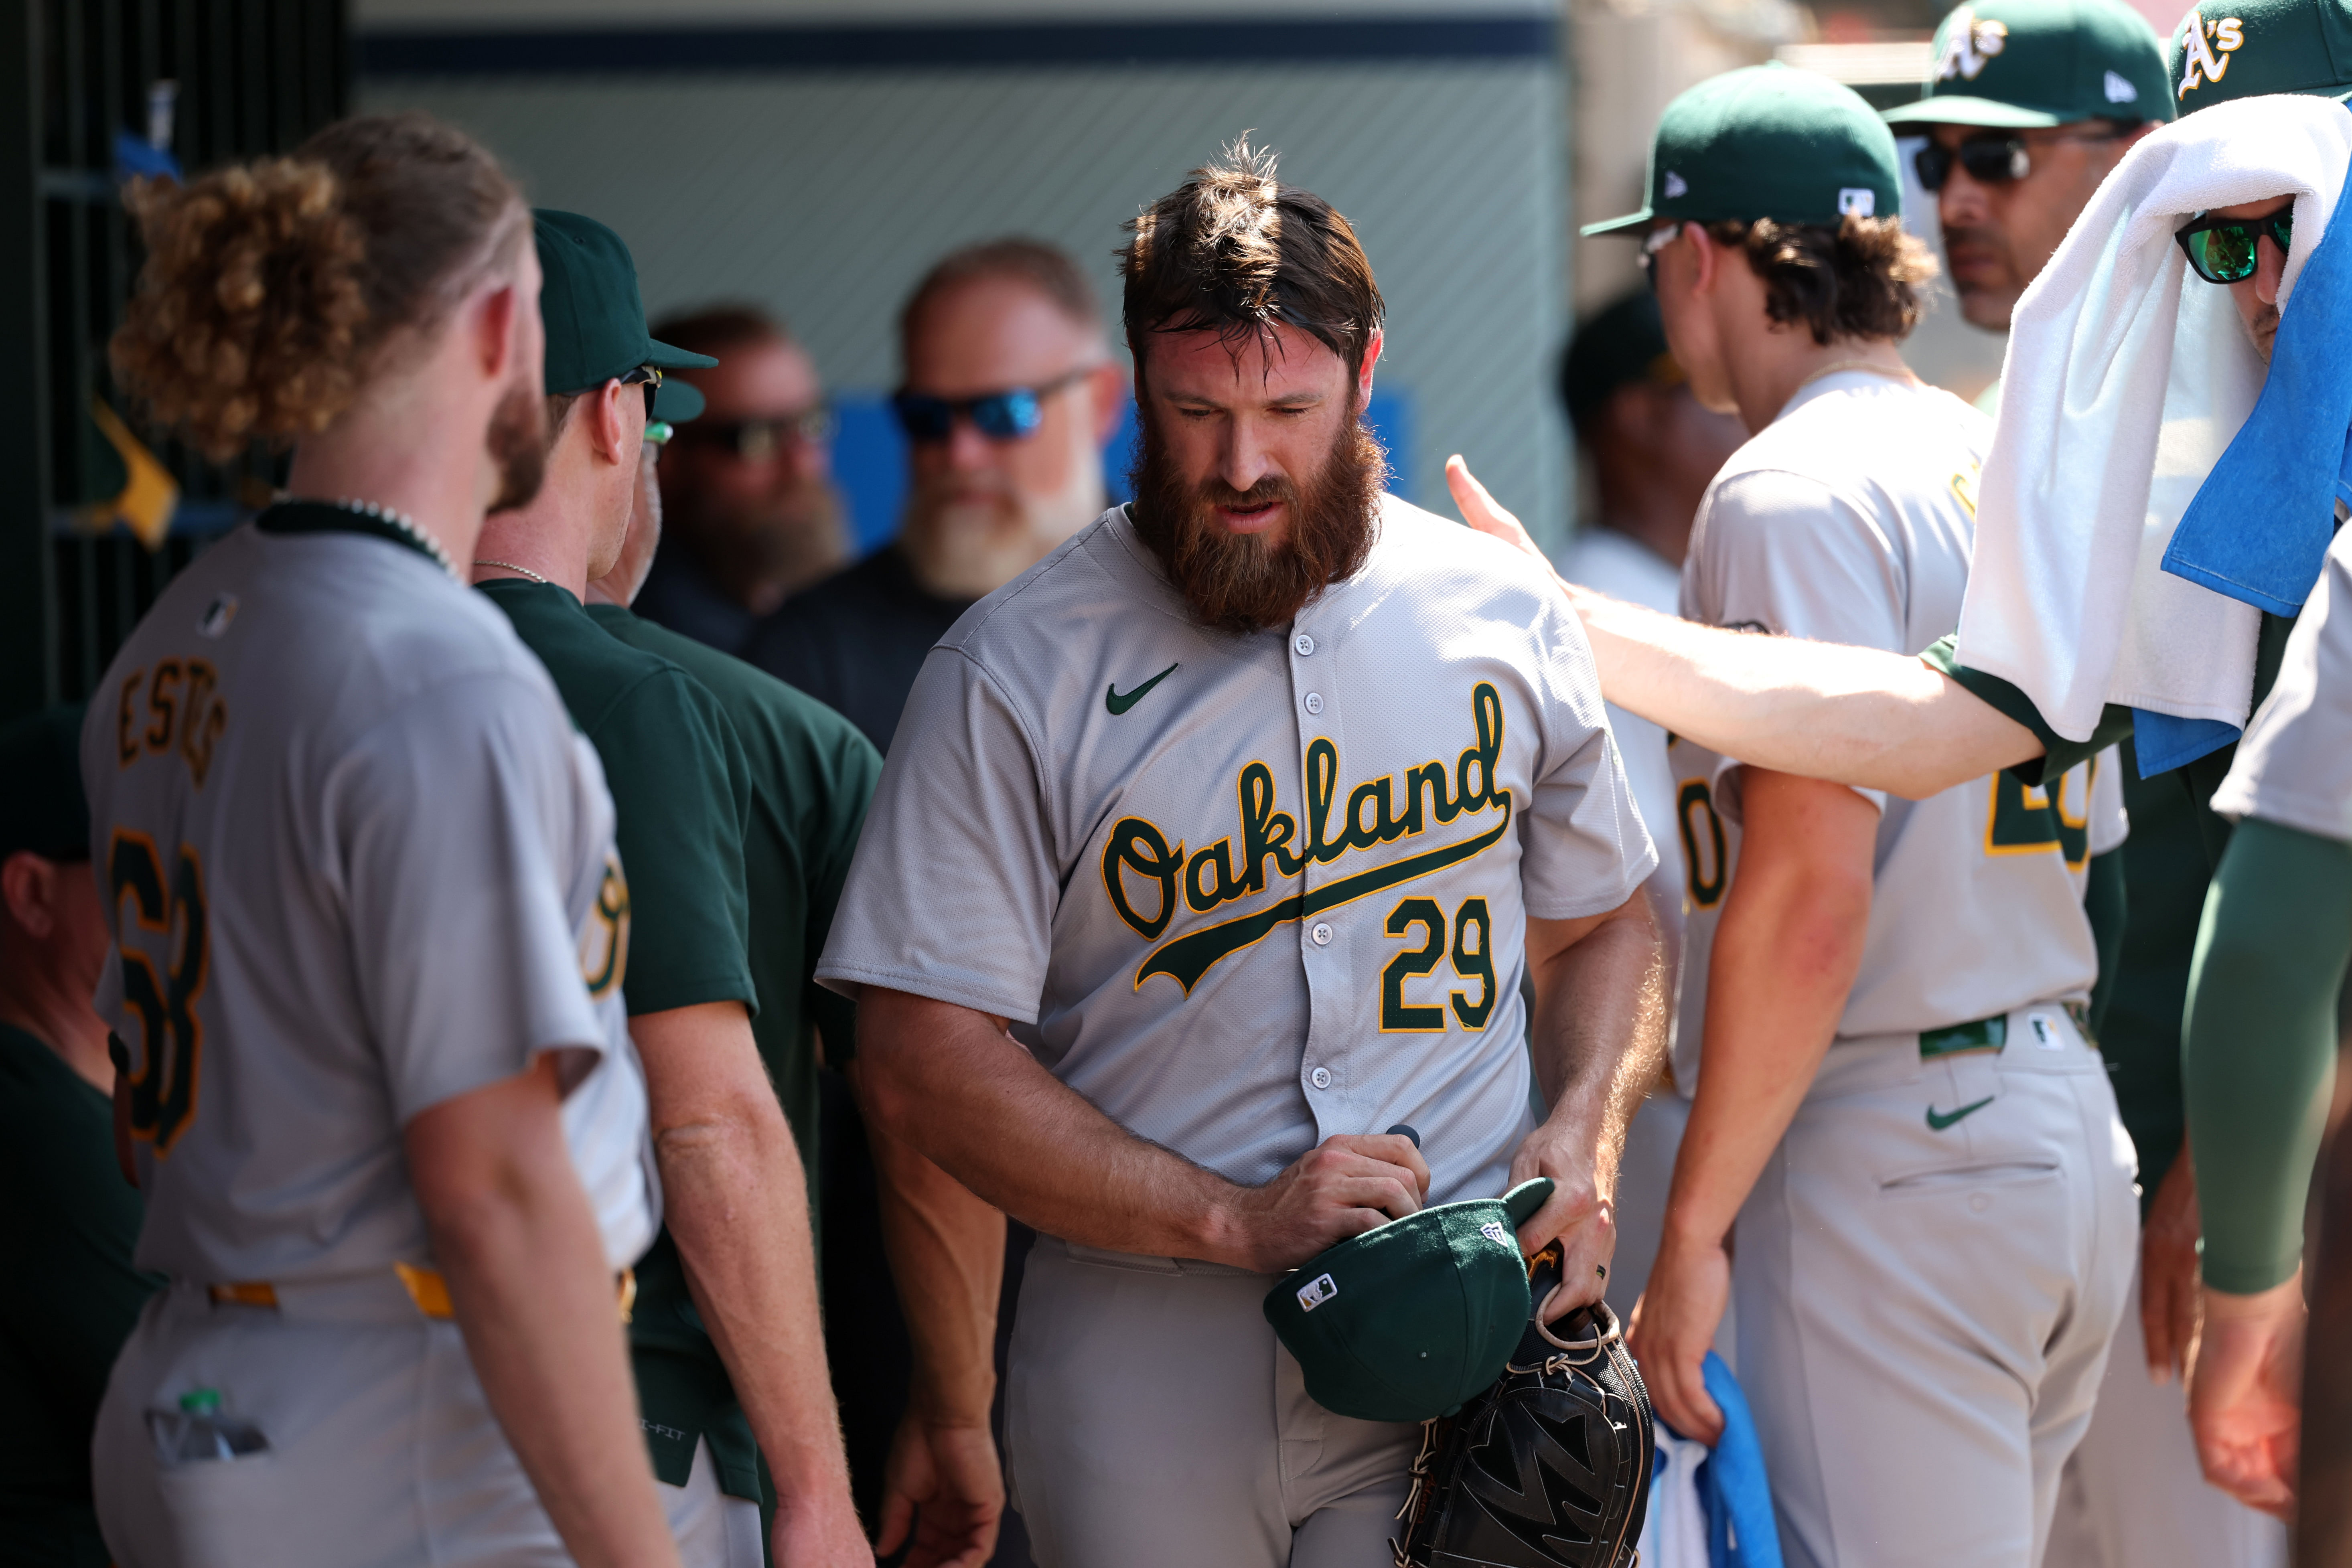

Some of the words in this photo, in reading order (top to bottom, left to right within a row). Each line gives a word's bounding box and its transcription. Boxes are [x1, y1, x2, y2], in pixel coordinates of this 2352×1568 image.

[1934, 5, 2009, 83] A's
[2178, 11, 2244, 101] A's
[117, 654, 229, 795] ESTS
[1100, 681, 1512, 942] Oakland
[1379, 895, 1498, 1033] 29
